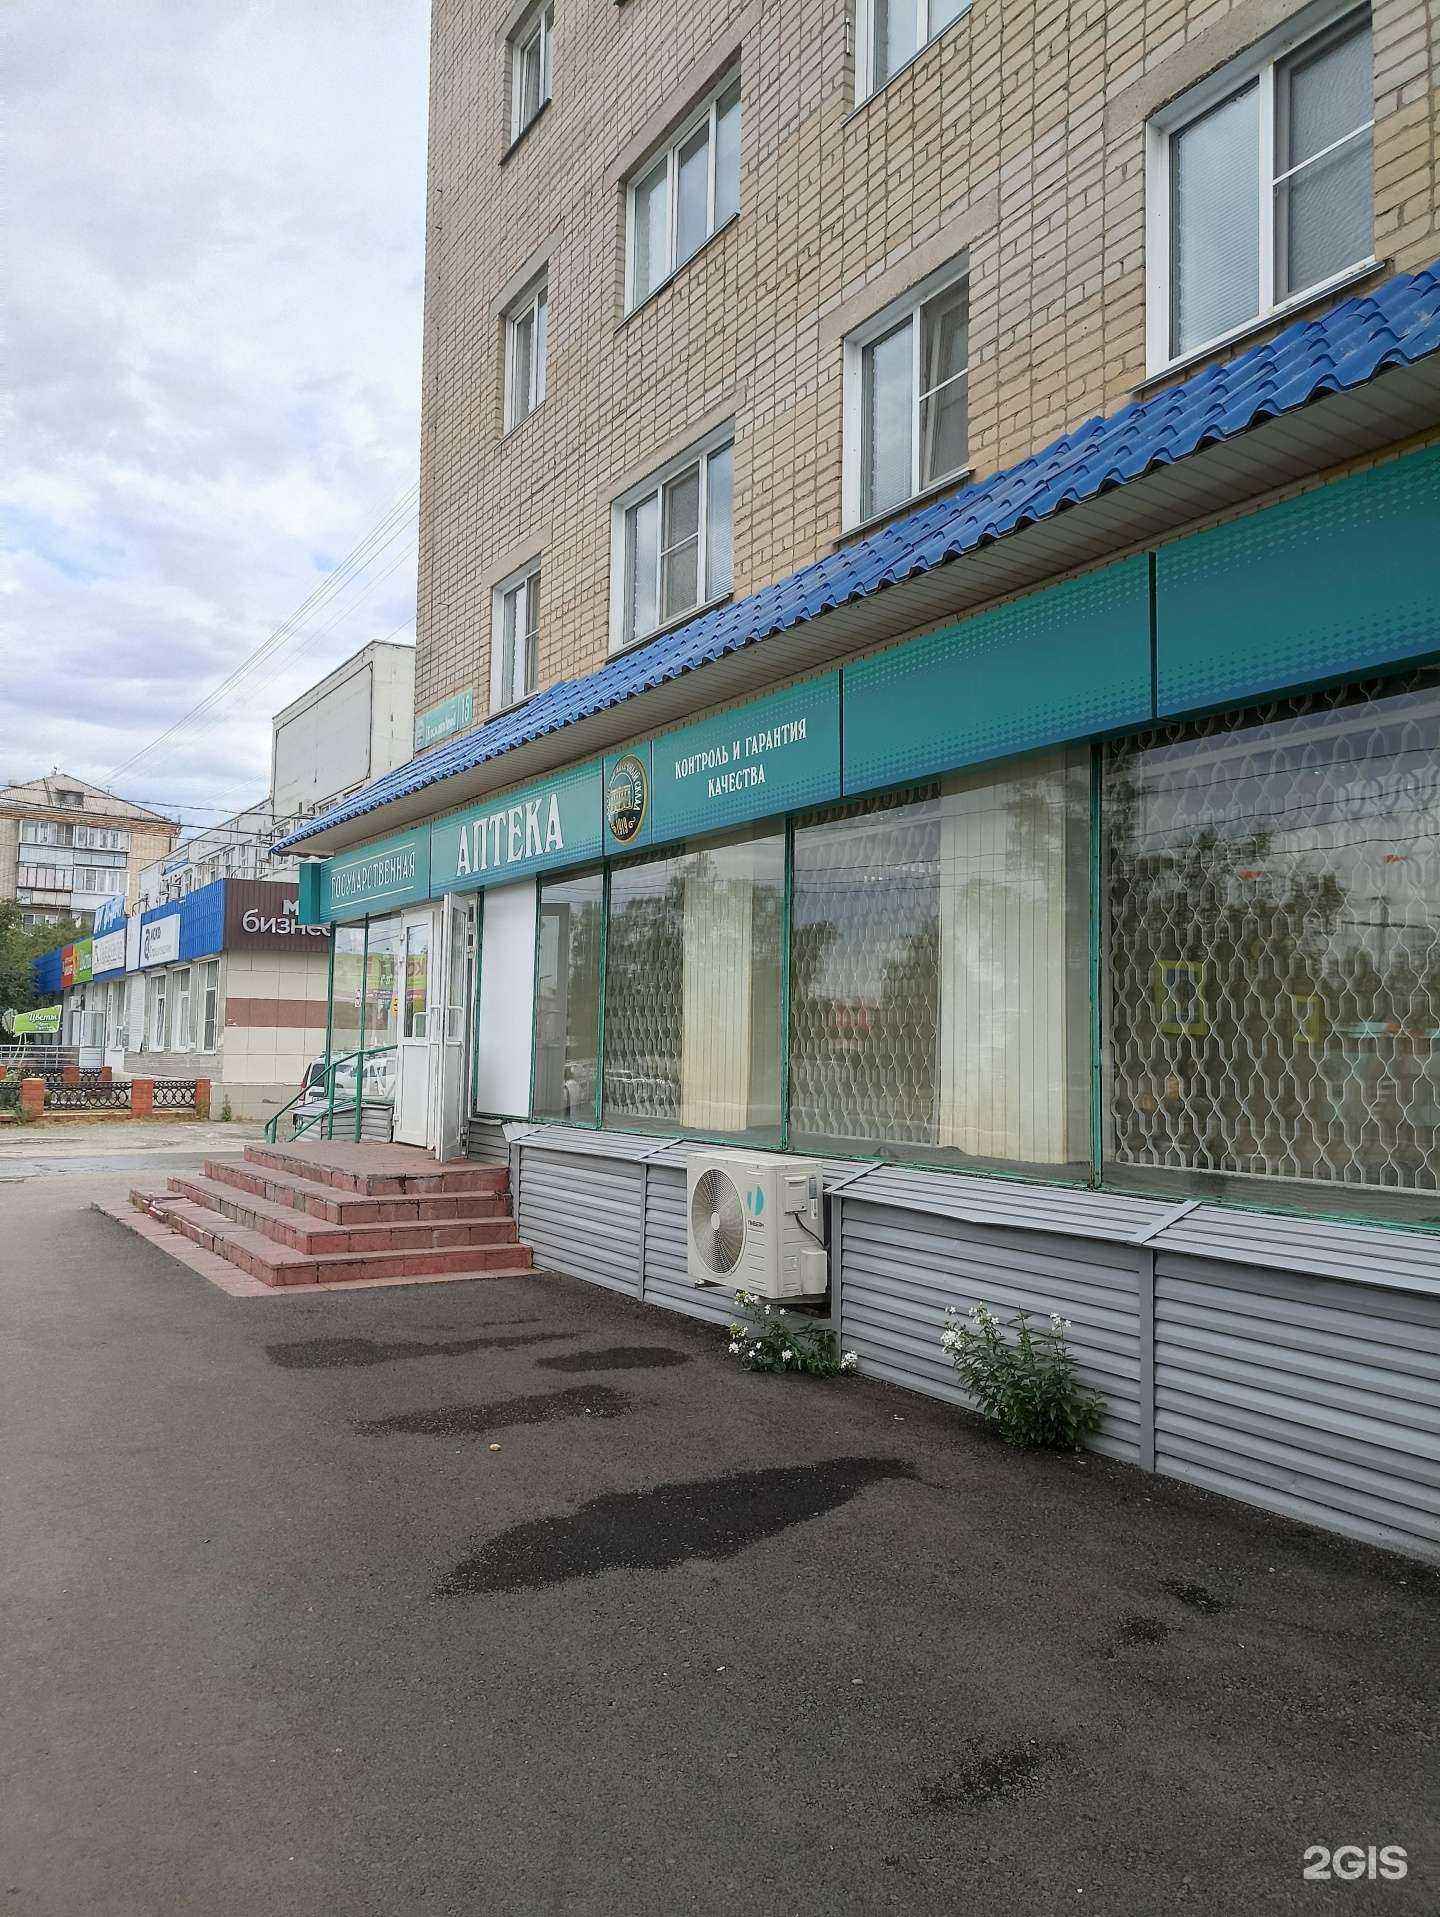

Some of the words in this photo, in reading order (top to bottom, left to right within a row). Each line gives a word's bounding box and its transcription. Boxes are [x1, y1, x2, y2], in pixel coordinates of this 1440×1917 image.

[675, 746, 729, 780] КОНТРОЛЬ
[732, 740, 740, 761] И
[745, 717, 807, 757] ГАРАНТИЯ
[707, 763, 766, 799] КАЧЕСТВА
[456, 793, 564, 877] АПТЕКА
[331, 850, 416, 900] ГОСУДАРСТВЕННАЯ
